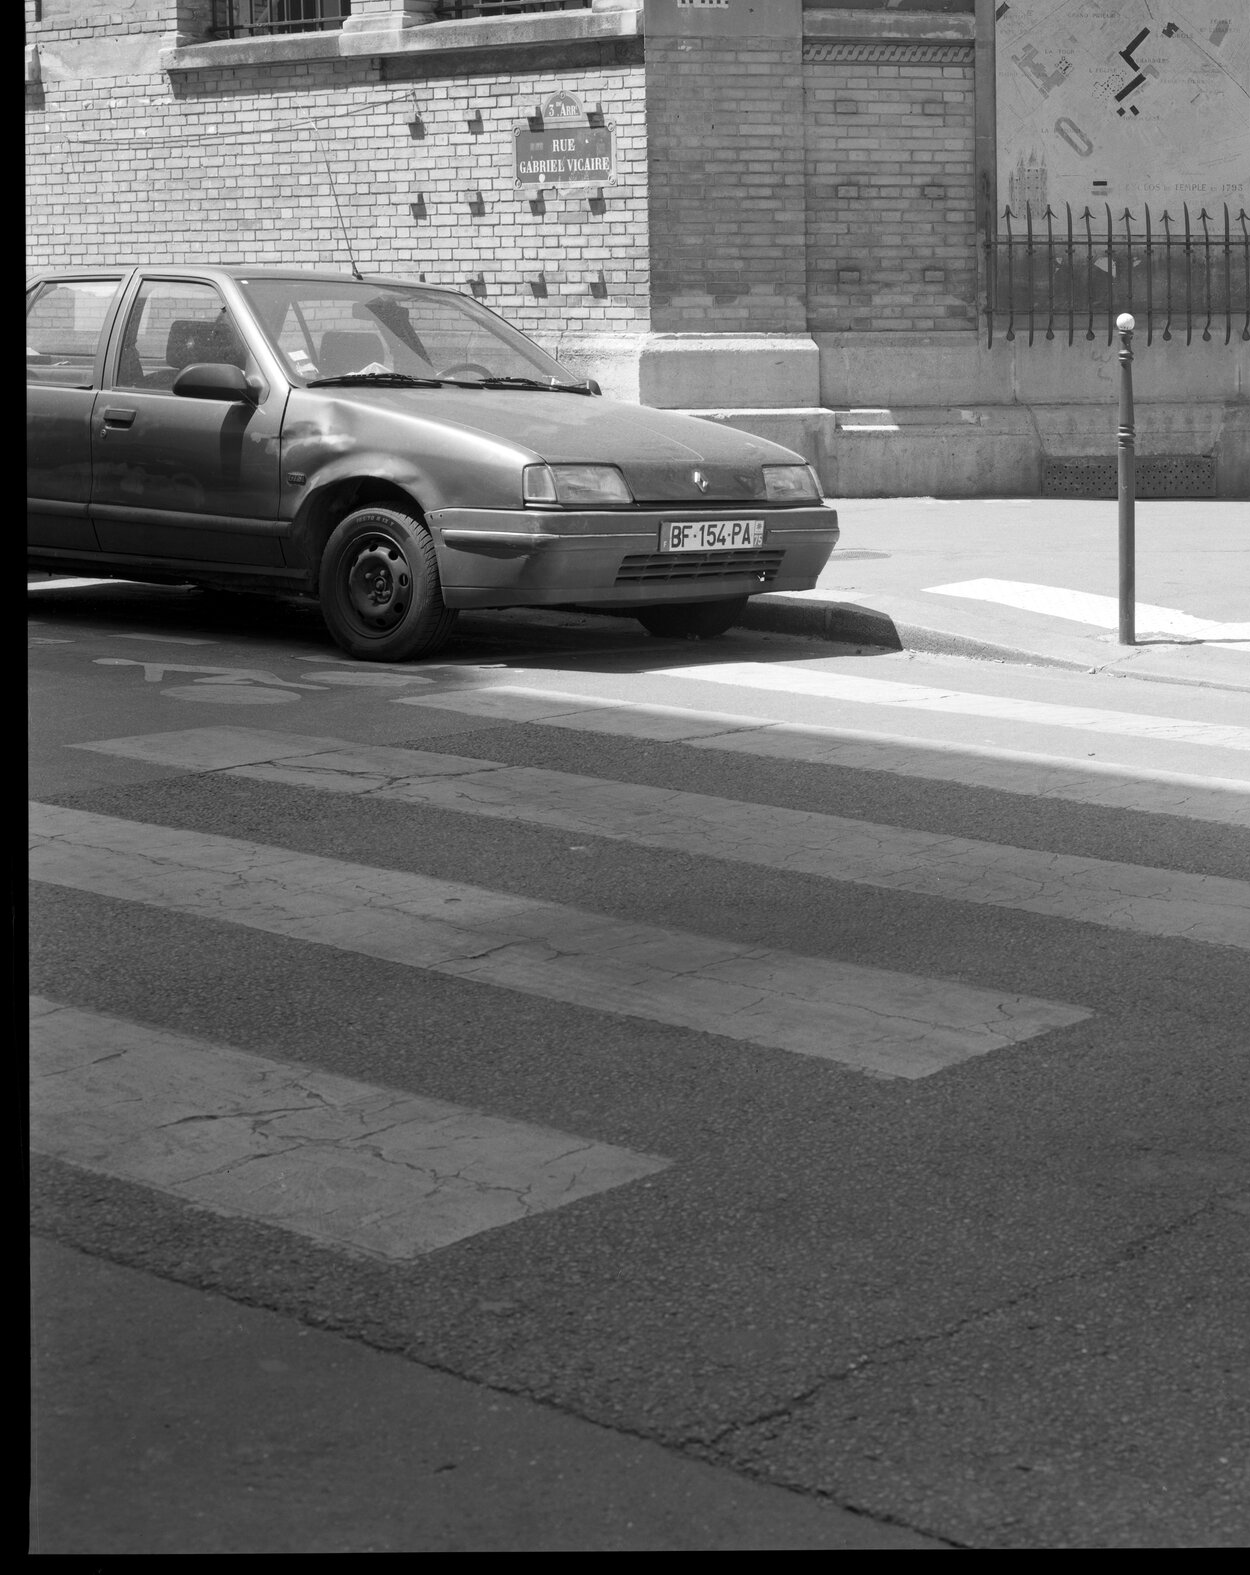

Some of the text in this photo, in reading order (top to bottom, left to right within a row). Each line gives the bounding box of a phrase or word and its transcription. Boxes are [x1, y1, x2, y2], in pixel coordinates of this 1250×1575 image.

[552, 138, 576, 153] RUE
[519, 157, 610, 174] GABRIEL VICAIRE
[1175, 183, 1206, 192] TEMPLE
[754, 534, 763, 546] 75
